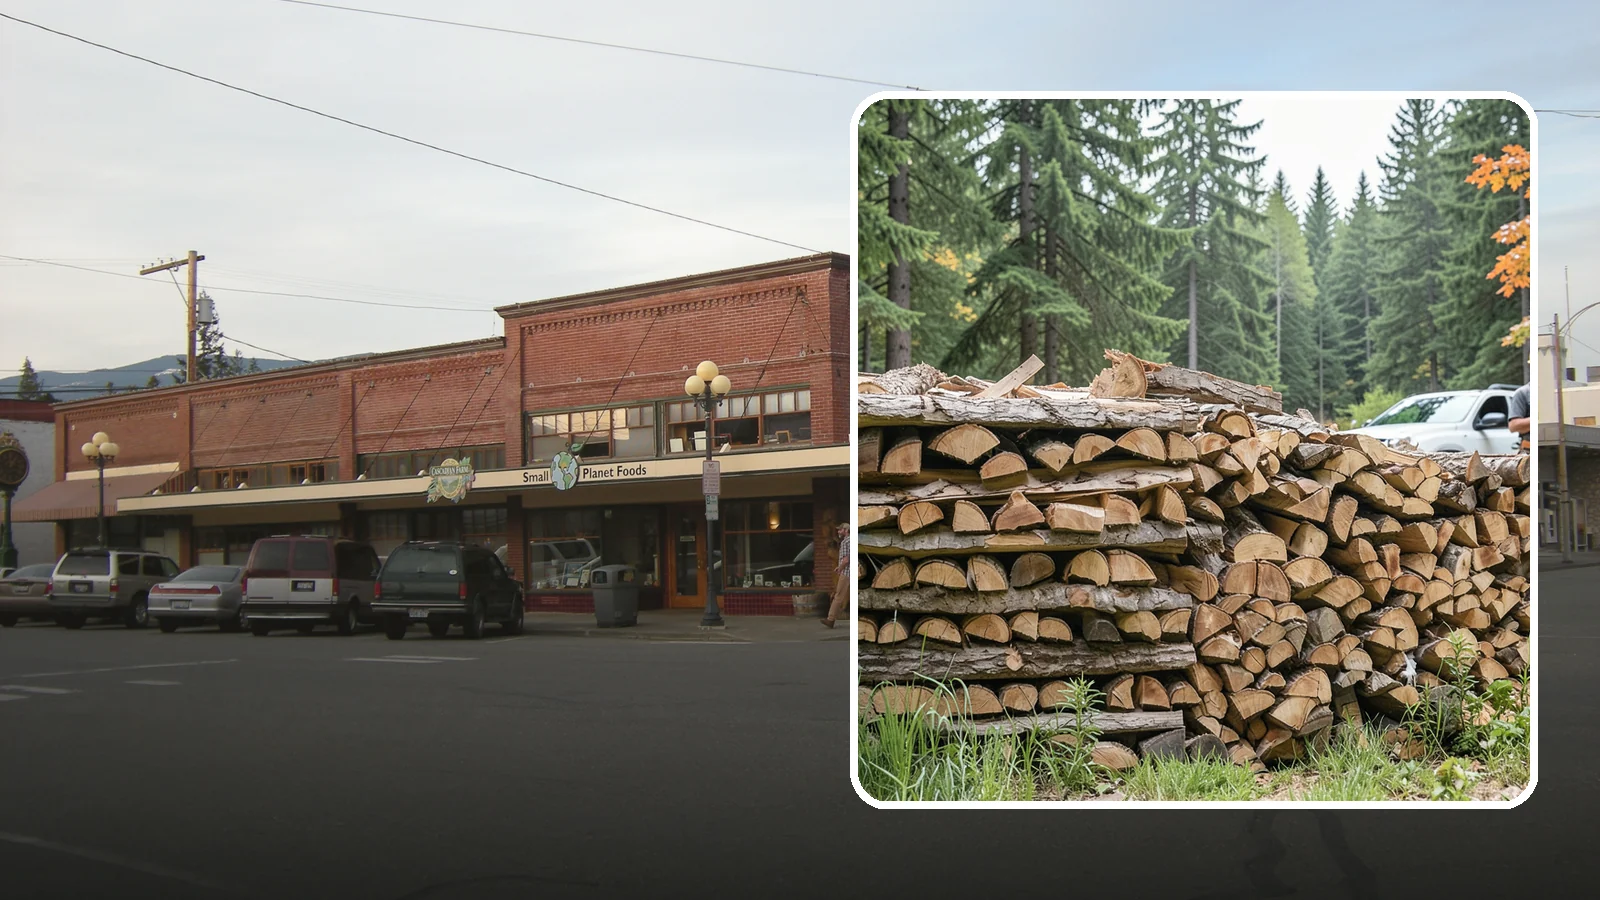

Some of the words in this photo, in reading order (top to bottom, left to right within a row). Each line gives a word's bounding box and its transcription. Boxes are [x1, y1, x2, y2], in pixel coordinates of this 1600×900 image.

[523, 471, 549, 483] Small
[582, 467, 614, 479] Planet
[616, 464, 647, 477] Foods
